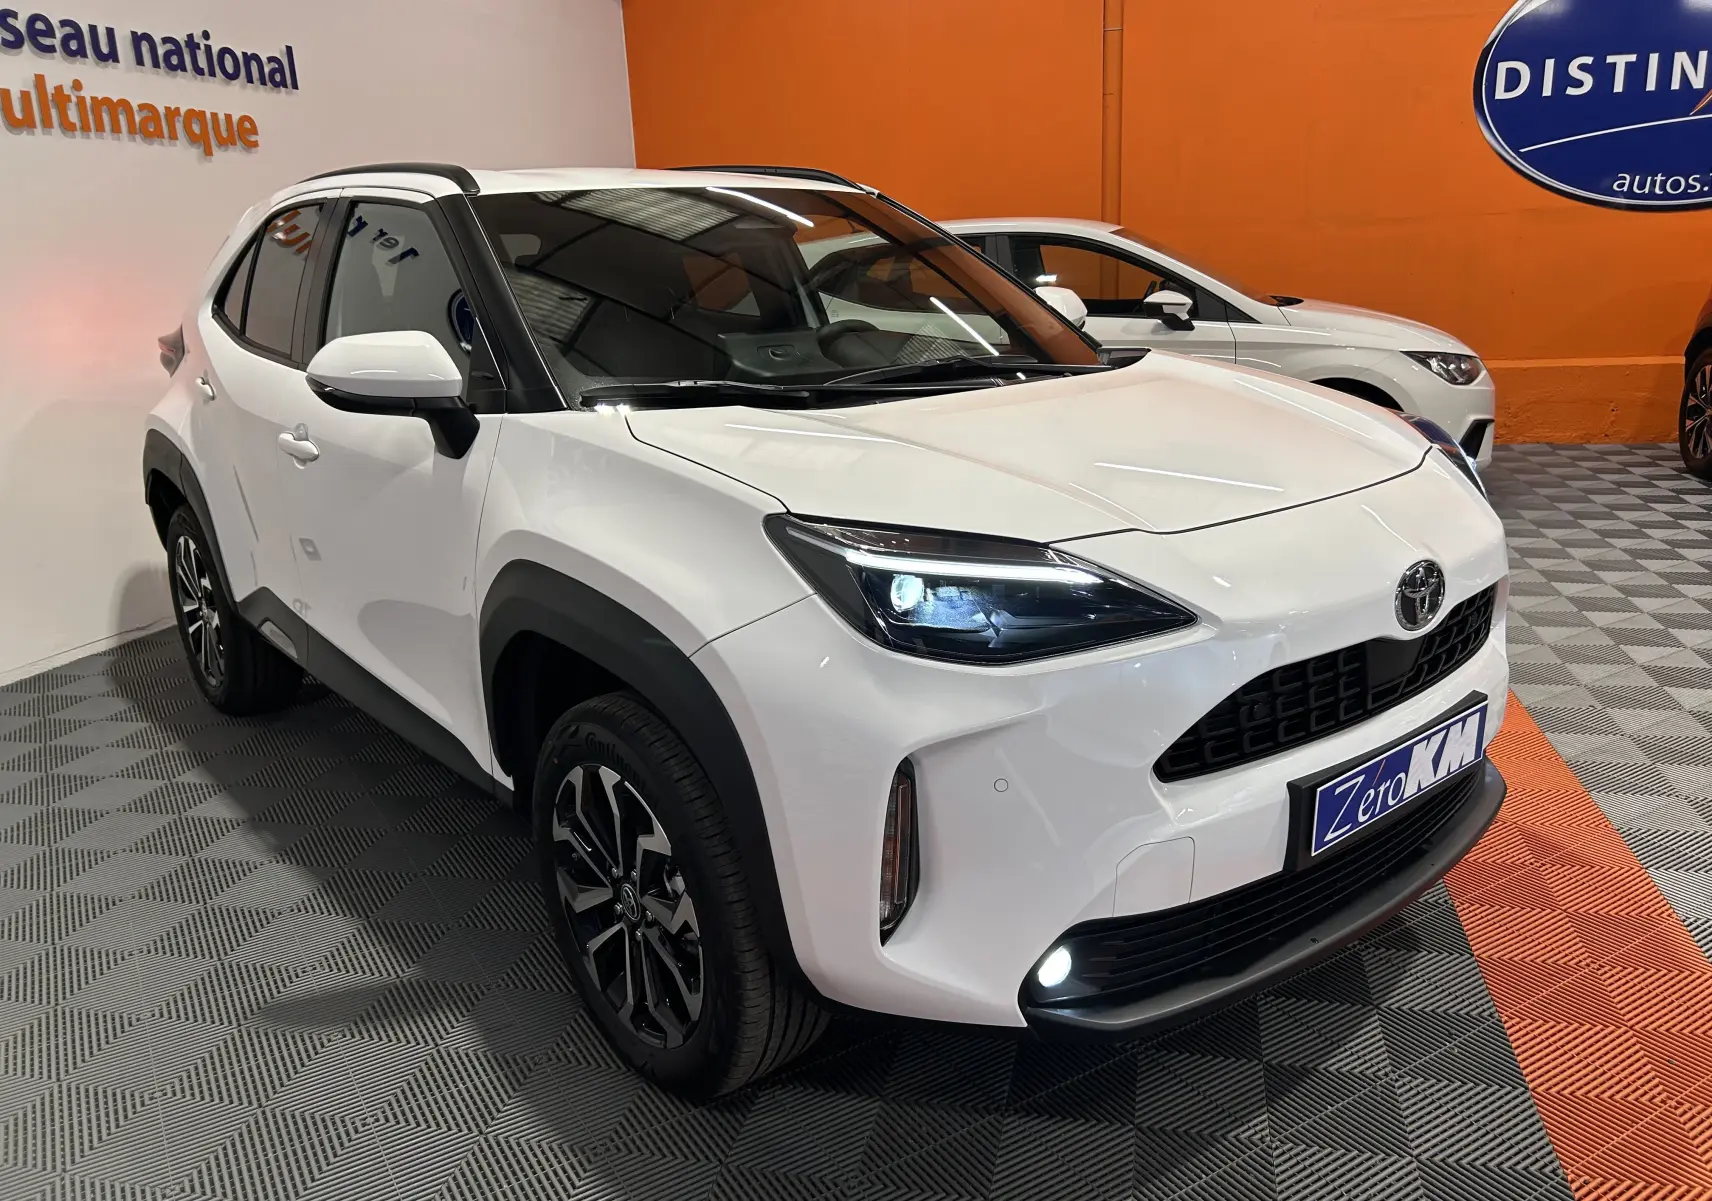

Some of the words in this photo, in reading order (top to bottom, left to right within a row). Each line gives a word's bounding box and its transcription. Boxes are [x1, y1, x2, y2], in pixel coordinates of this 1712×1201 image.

[130, 30, 299, 90] national
[1494, 50, 1708, 100] DISTIN
[0, 73, 259, 156] ultimarque
[1612, 172, 1712, 195] autos.
